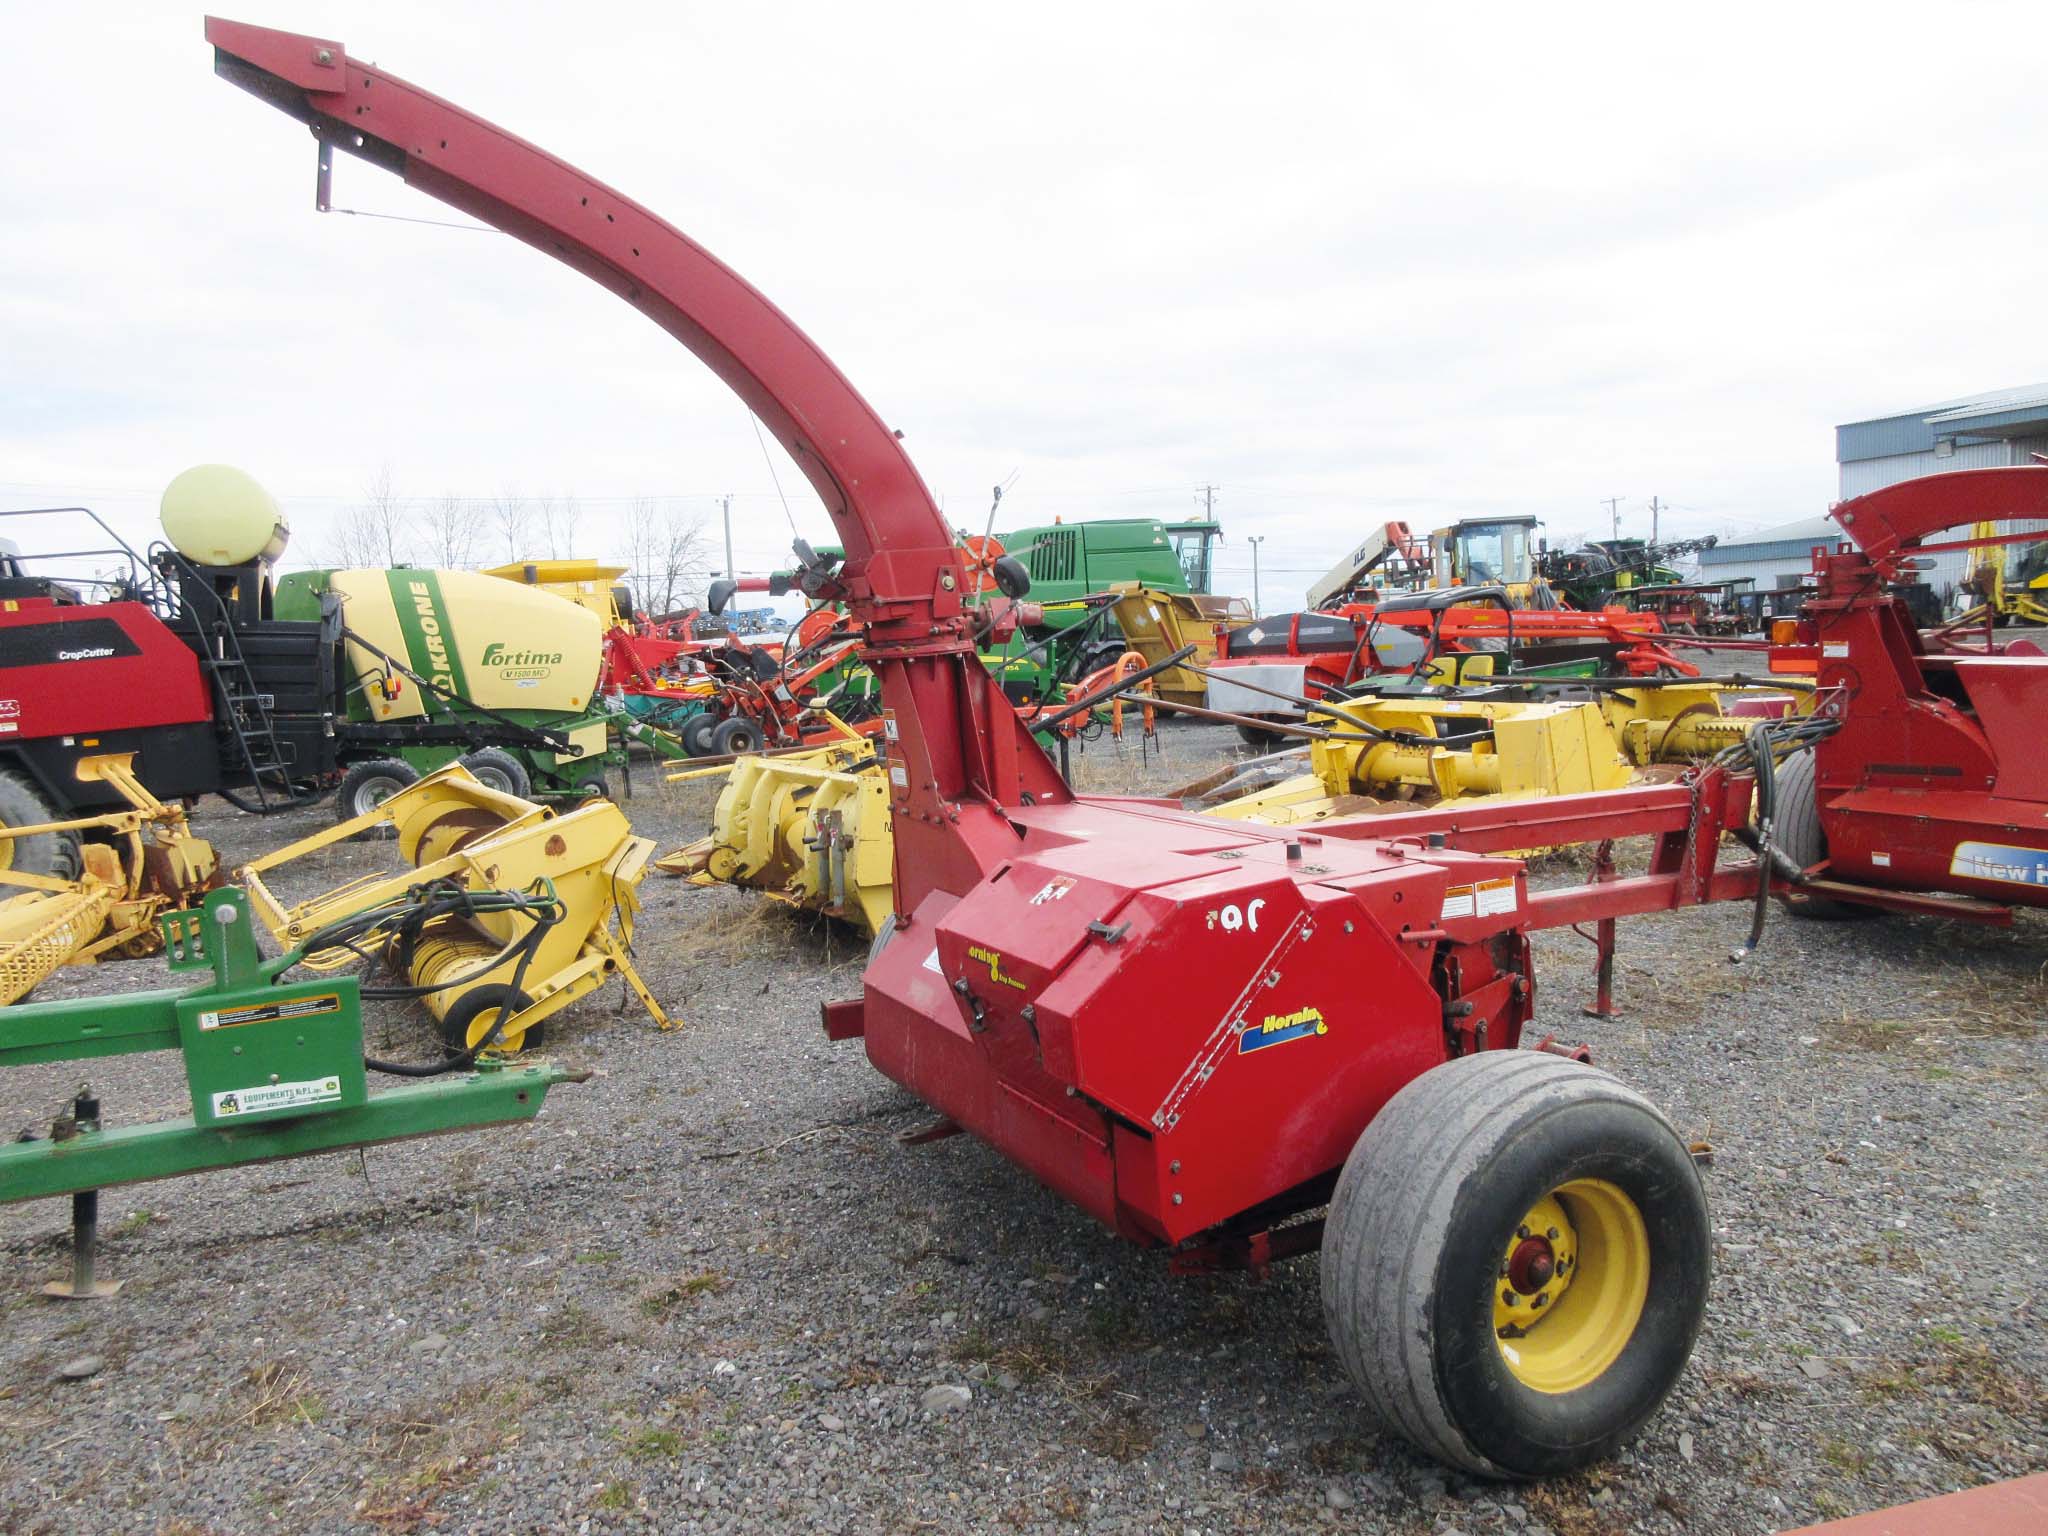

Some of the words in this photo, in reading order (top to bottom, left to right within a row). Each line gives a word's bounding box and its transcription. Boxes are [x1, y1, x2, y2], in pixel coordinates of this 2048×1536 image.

[1353, 547, 1366, 568] JLG
[409, 582, 450, 671] KRONE
[59, 647, 115, 660] CropCutter
[481, 642, 563, 666] Fortima
[1973, 855, 2030, 881] New
